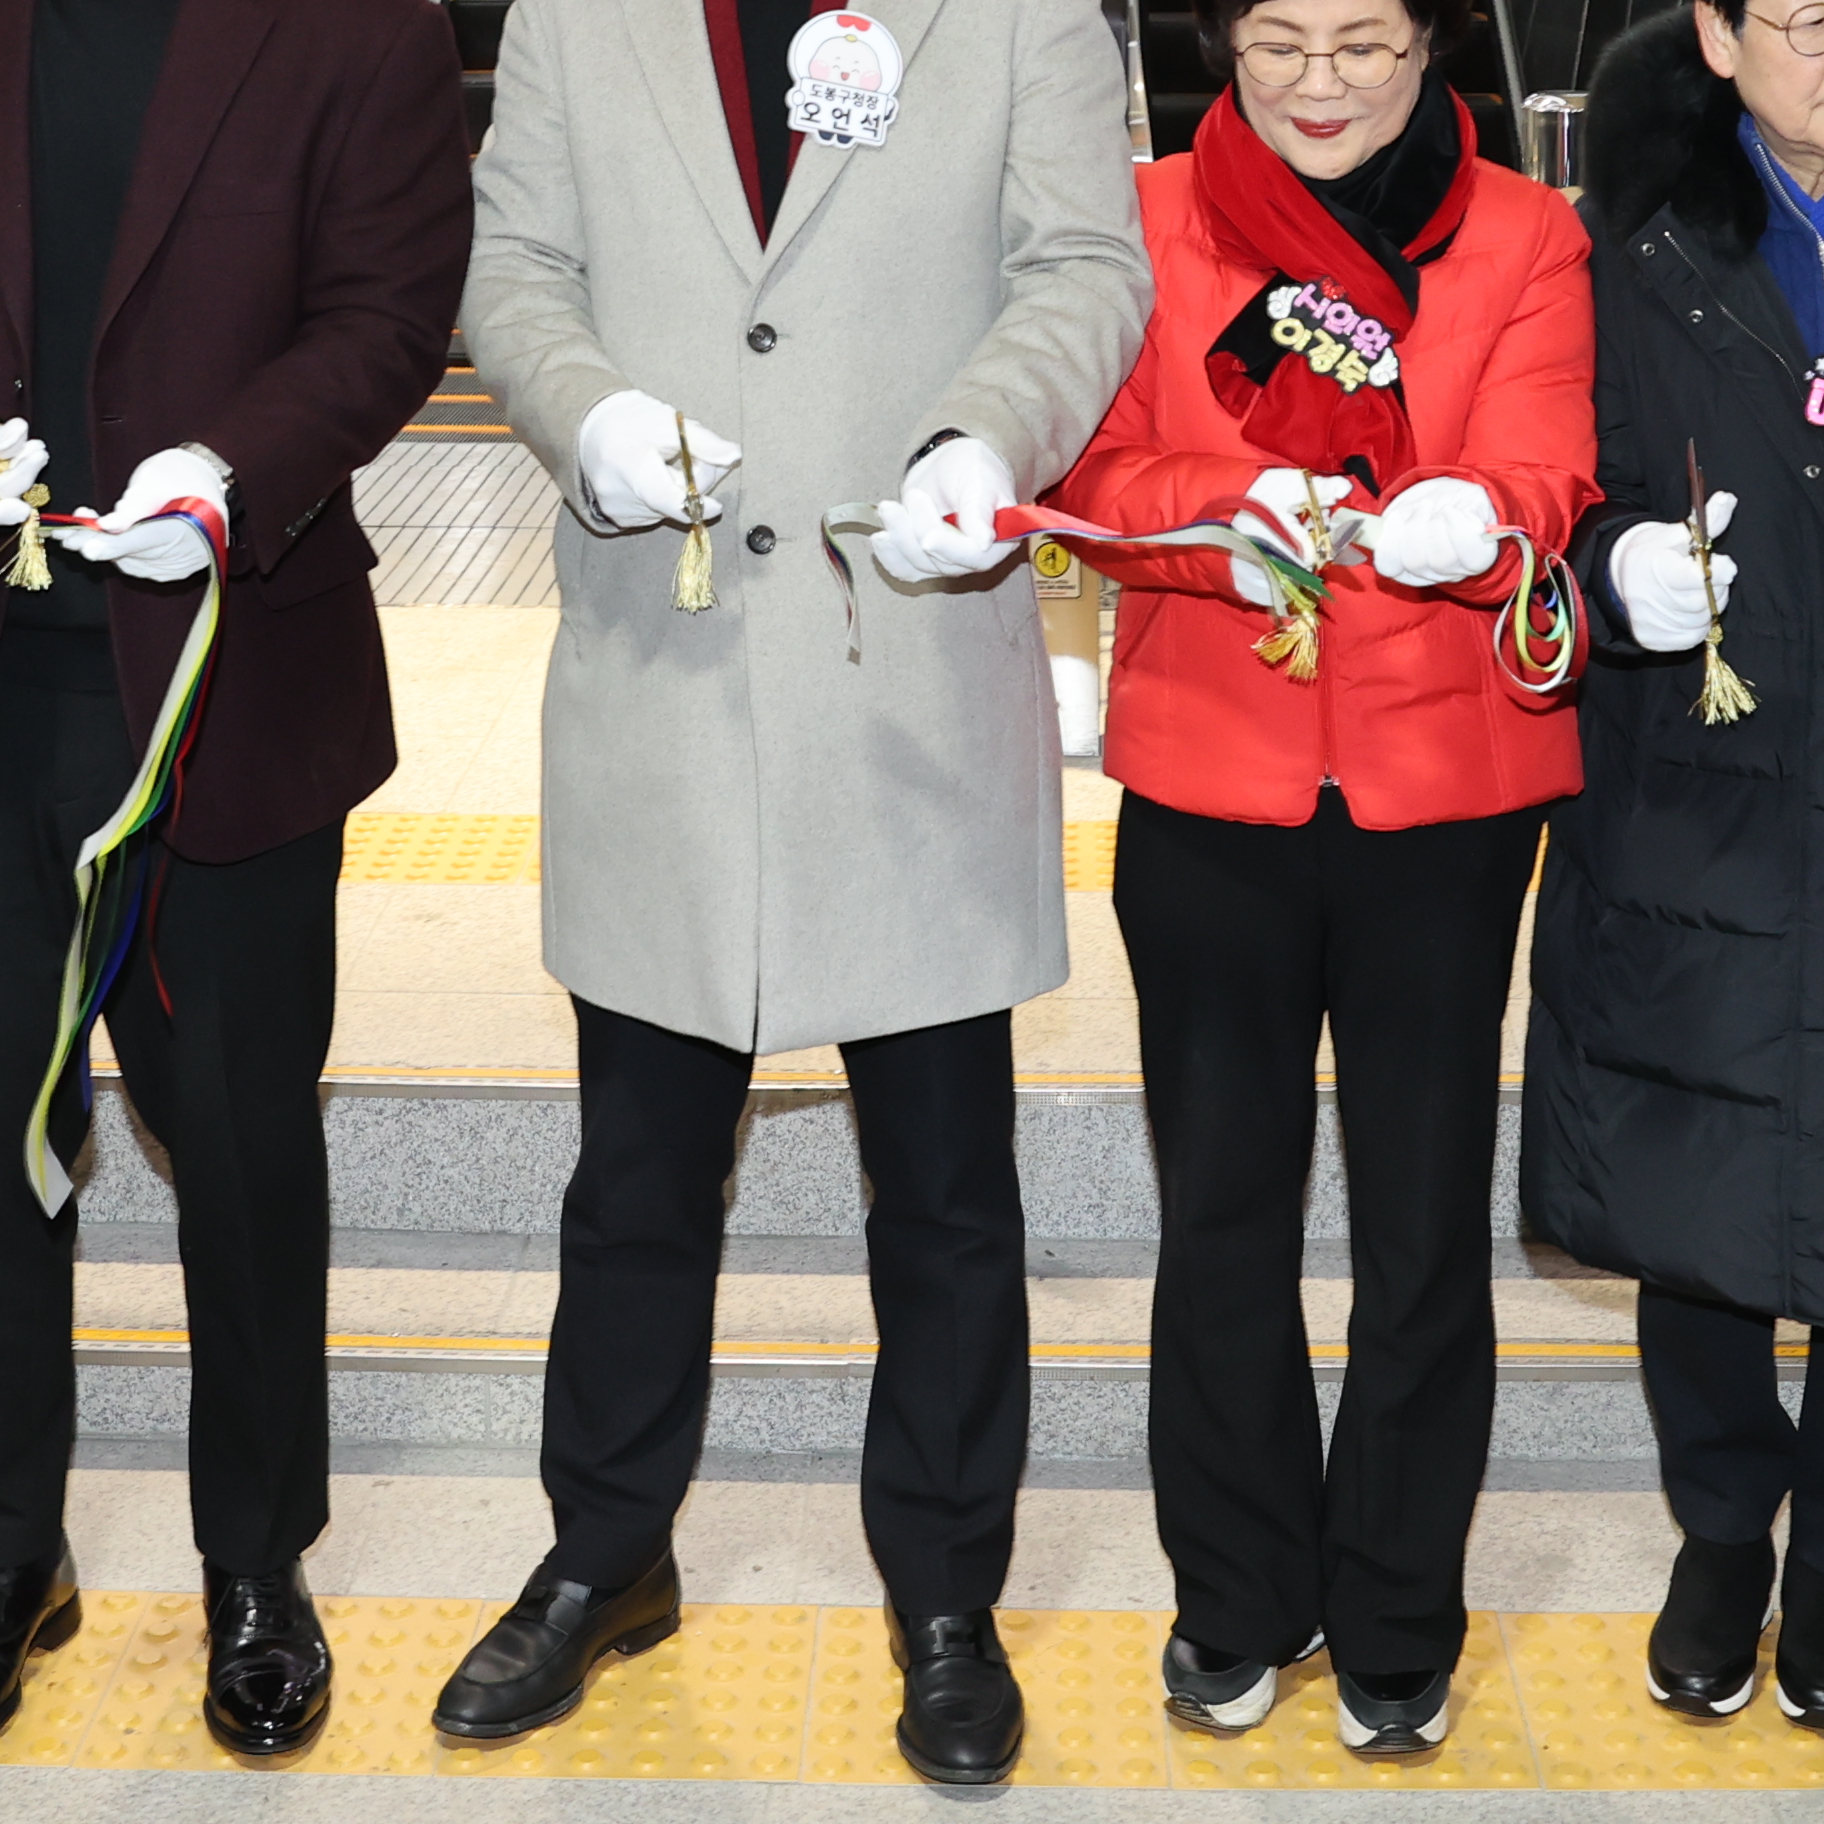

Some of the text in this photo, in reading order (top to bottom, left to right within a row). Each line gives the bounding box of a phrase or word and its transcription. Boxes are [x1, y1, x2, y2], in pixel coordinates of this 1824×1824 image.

[810, 83, 880, 110] 도봉구청장
[1271, 317, 1370, 392] 이경숙
[1293, 282, 1392, 360] 시의원
